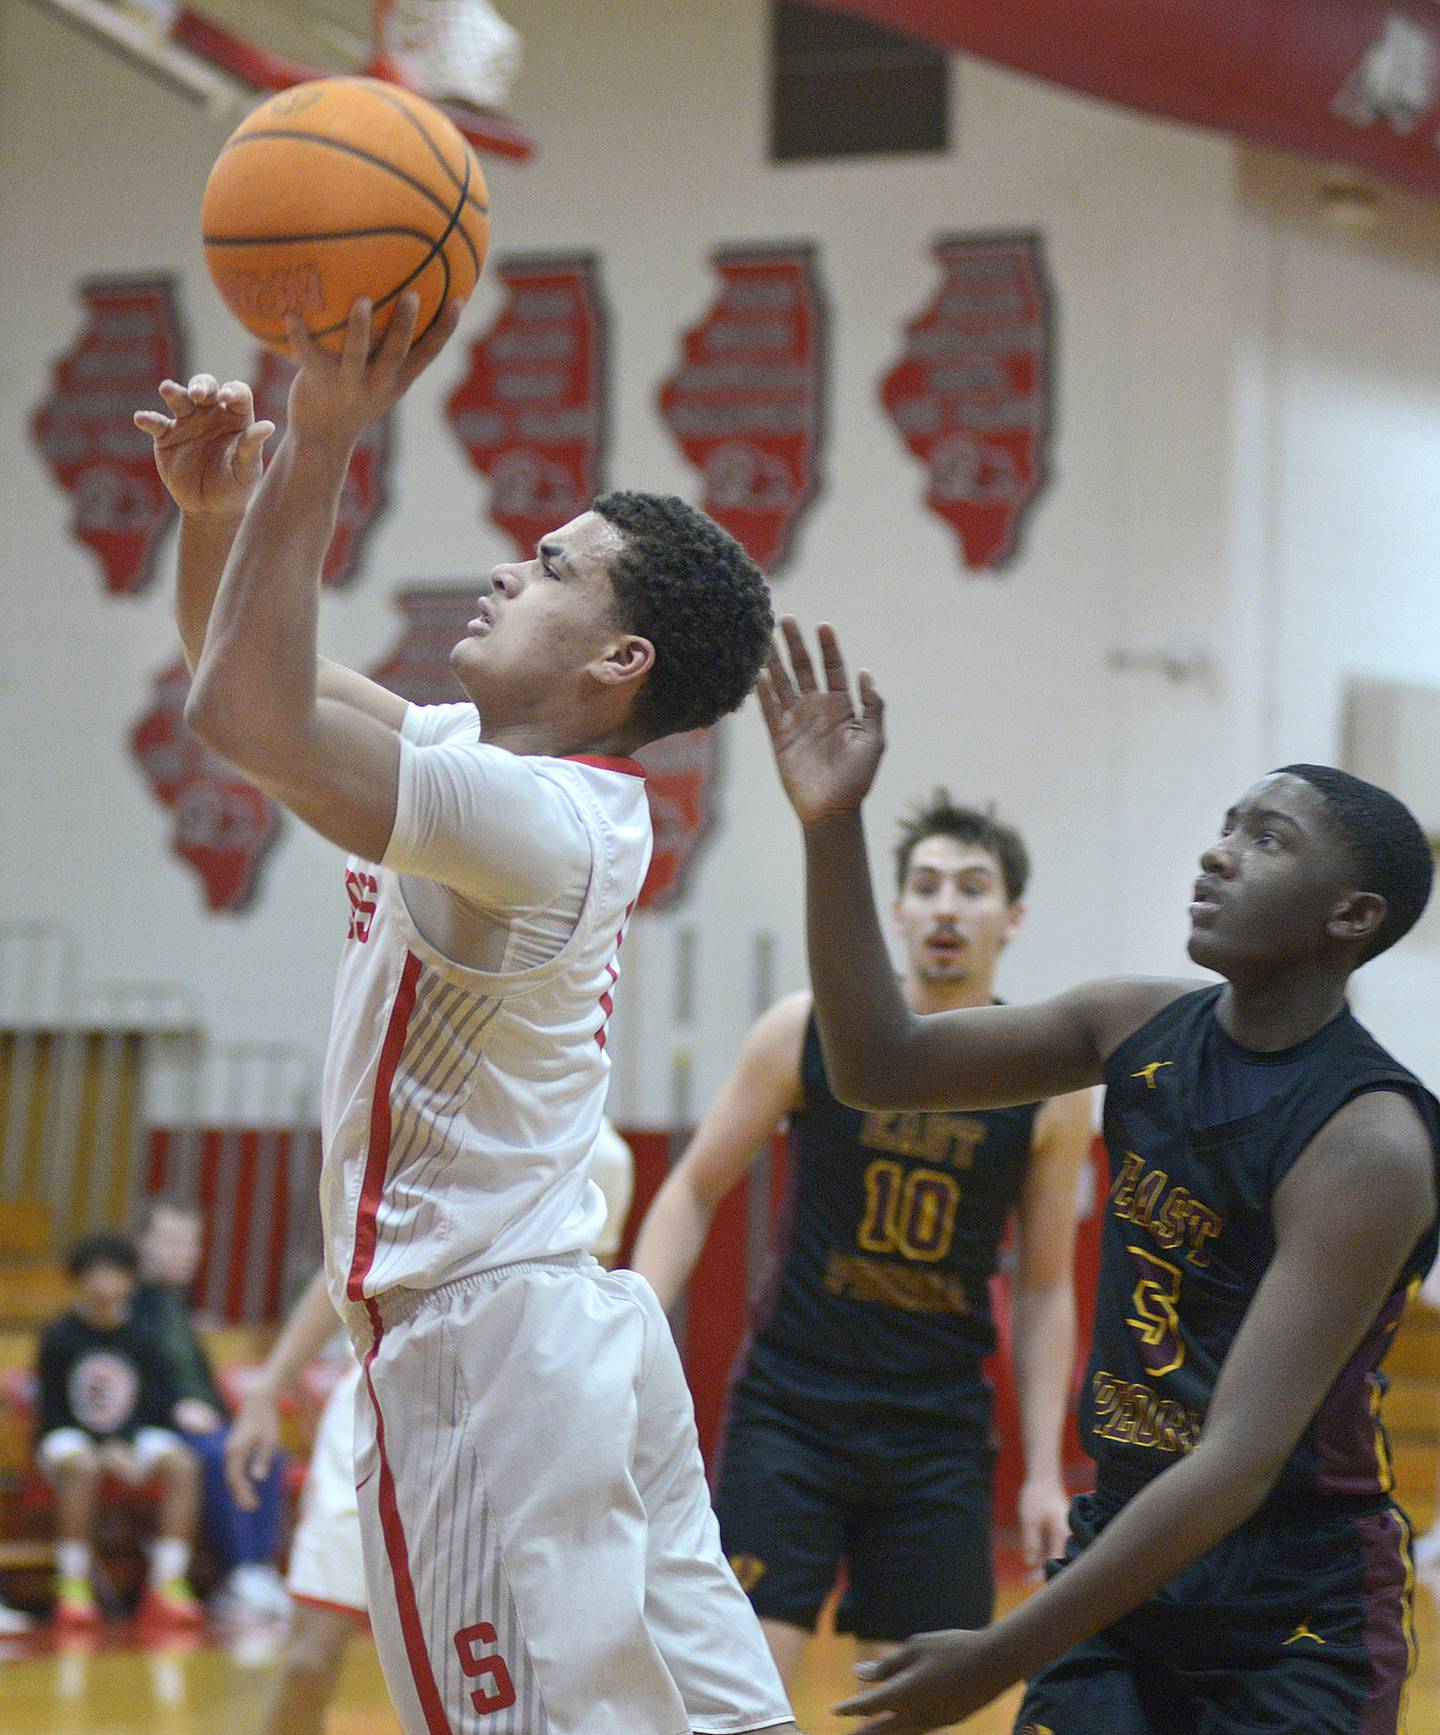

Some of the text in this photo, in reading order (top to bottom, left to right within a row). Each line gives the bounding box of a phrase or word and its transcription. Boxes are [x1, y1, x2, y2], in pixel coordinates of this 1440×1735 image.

[856, 1158, 961, 1262] 10
[1110, 1150, 1222, 1268] EAST
[1125, 1245, 1185, 1377] 5
[453, 1621, 517, 1715] S
